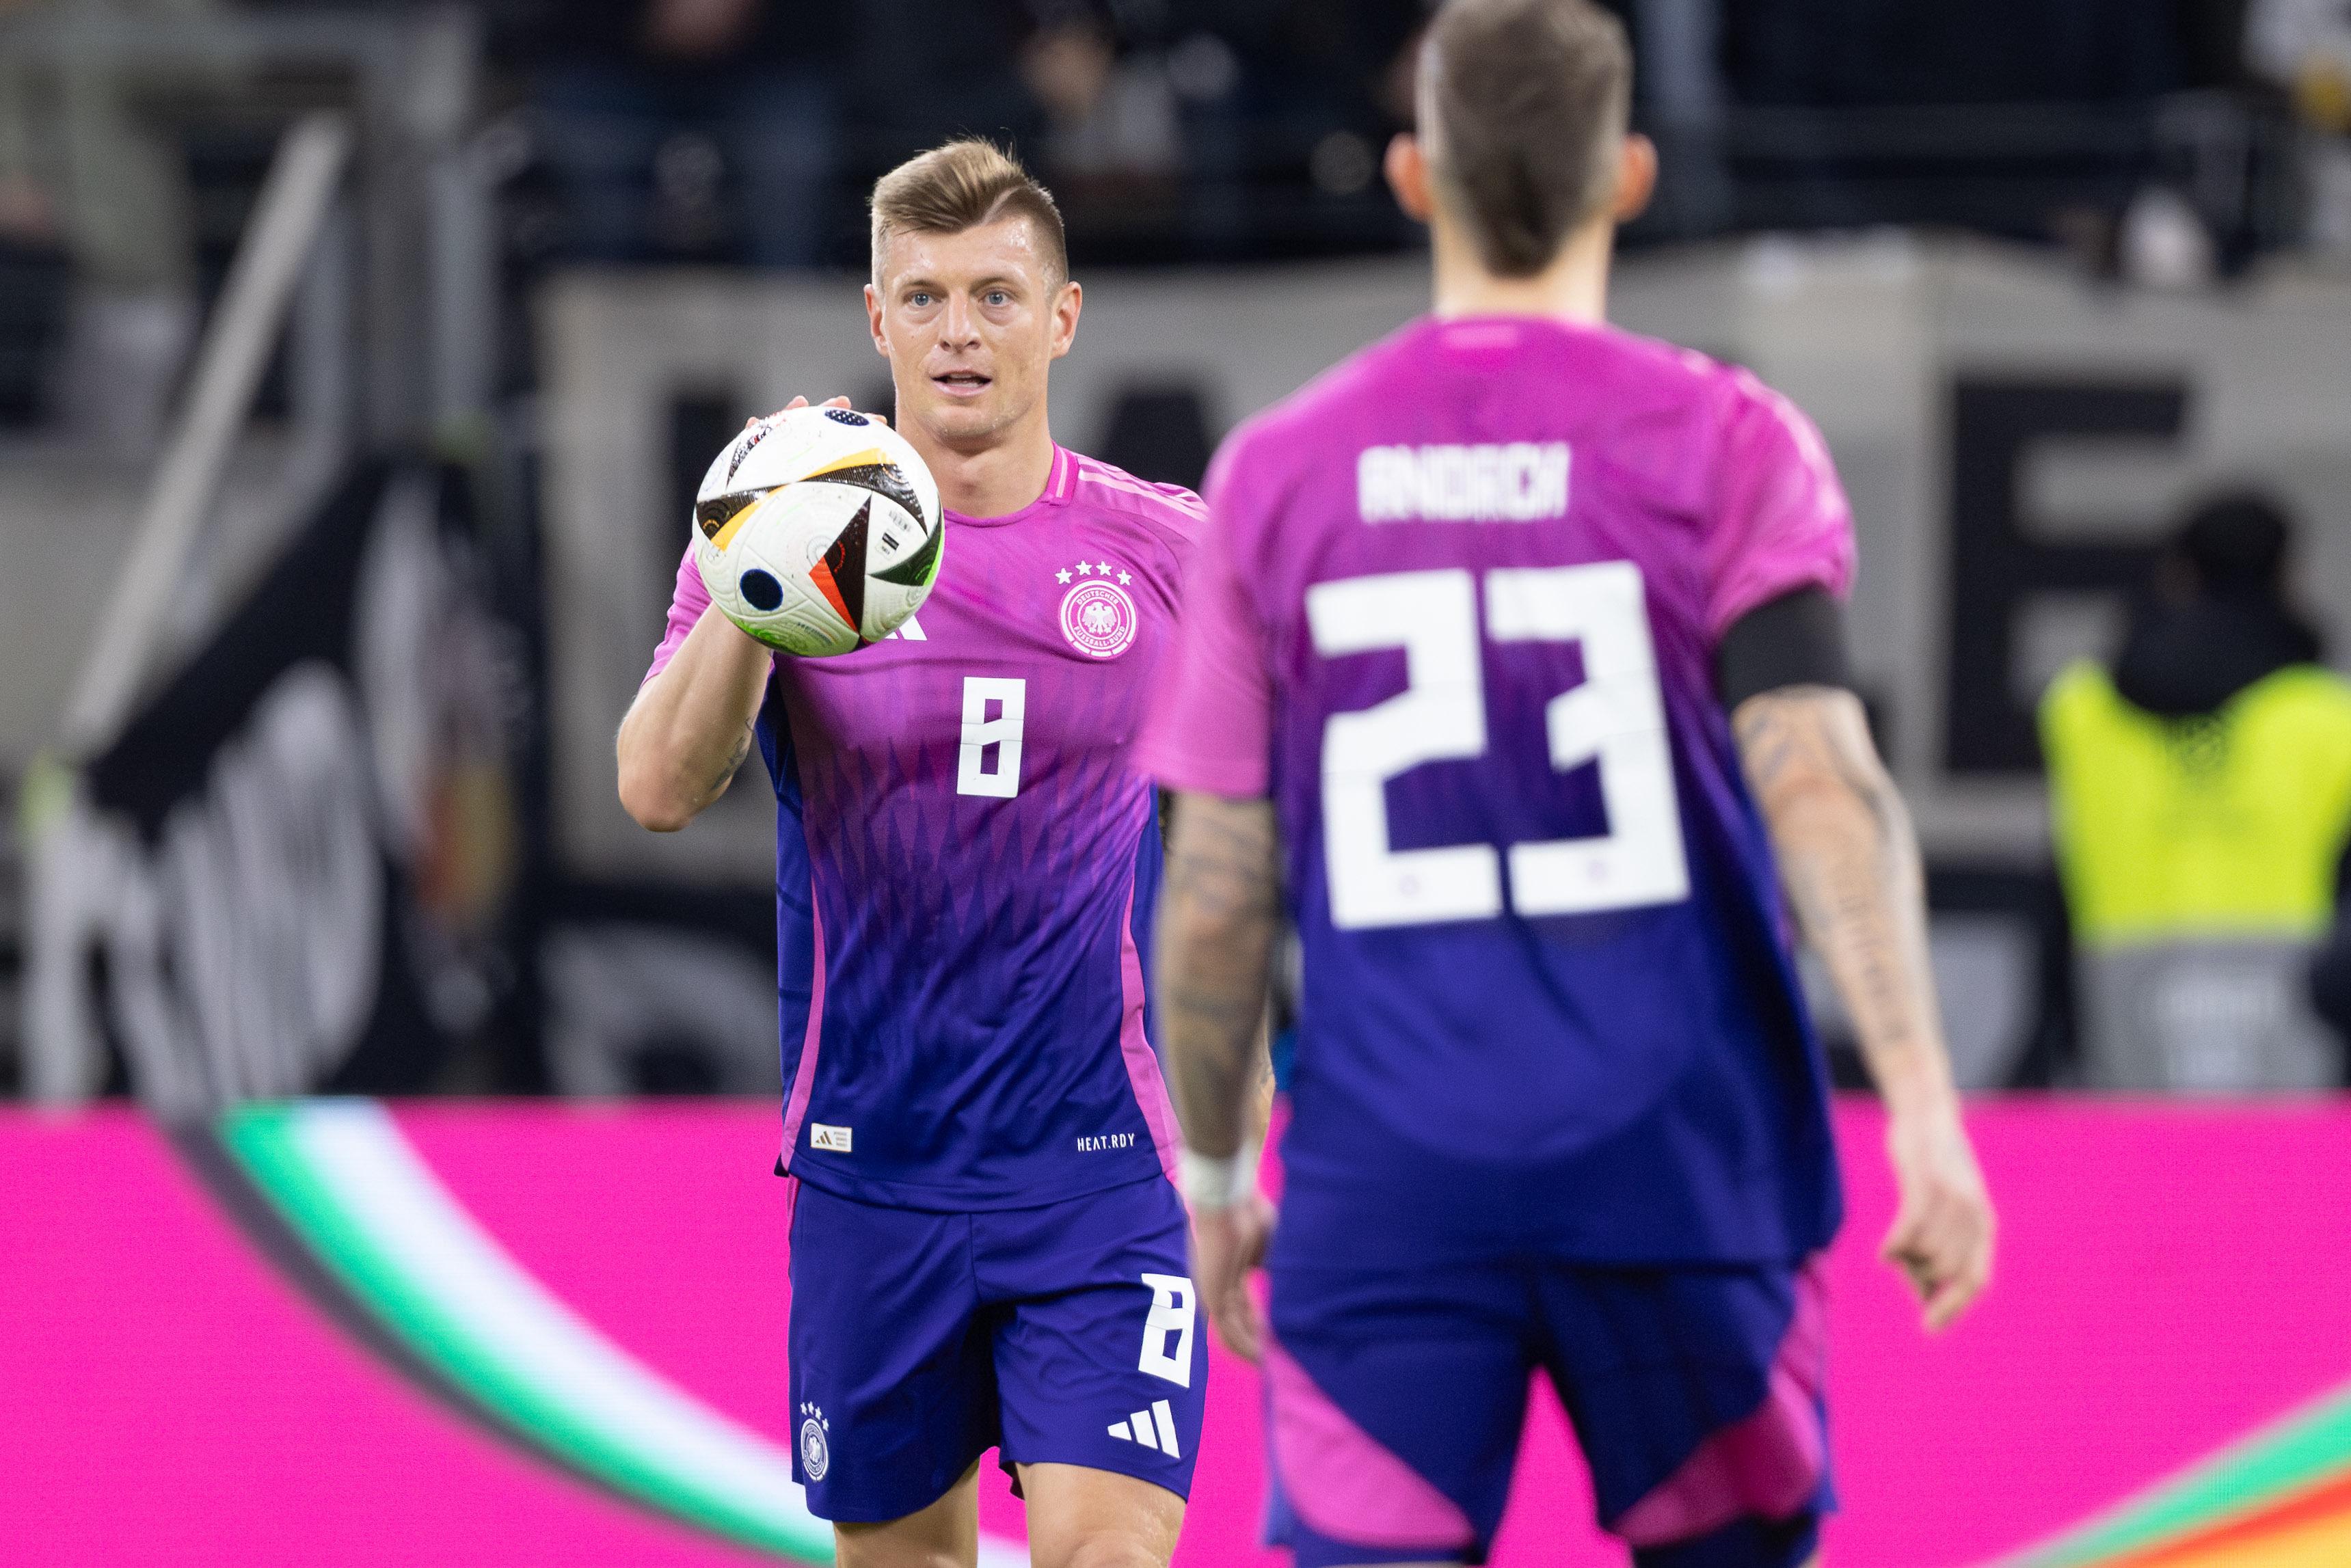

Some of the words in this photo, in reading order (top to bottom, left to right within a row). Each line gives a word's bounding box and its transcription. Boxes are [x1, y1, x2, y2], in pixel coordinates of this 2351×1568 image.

[1076, 591, 1119, 605] DEUTSCHER
[956, 677, 1025, 798] 8
[1307, 560, 1689, 930] 23
[1077, 1133, 1135, 1152] HEAT.RDY
[1138, 1273, 1196, 1388] 8
